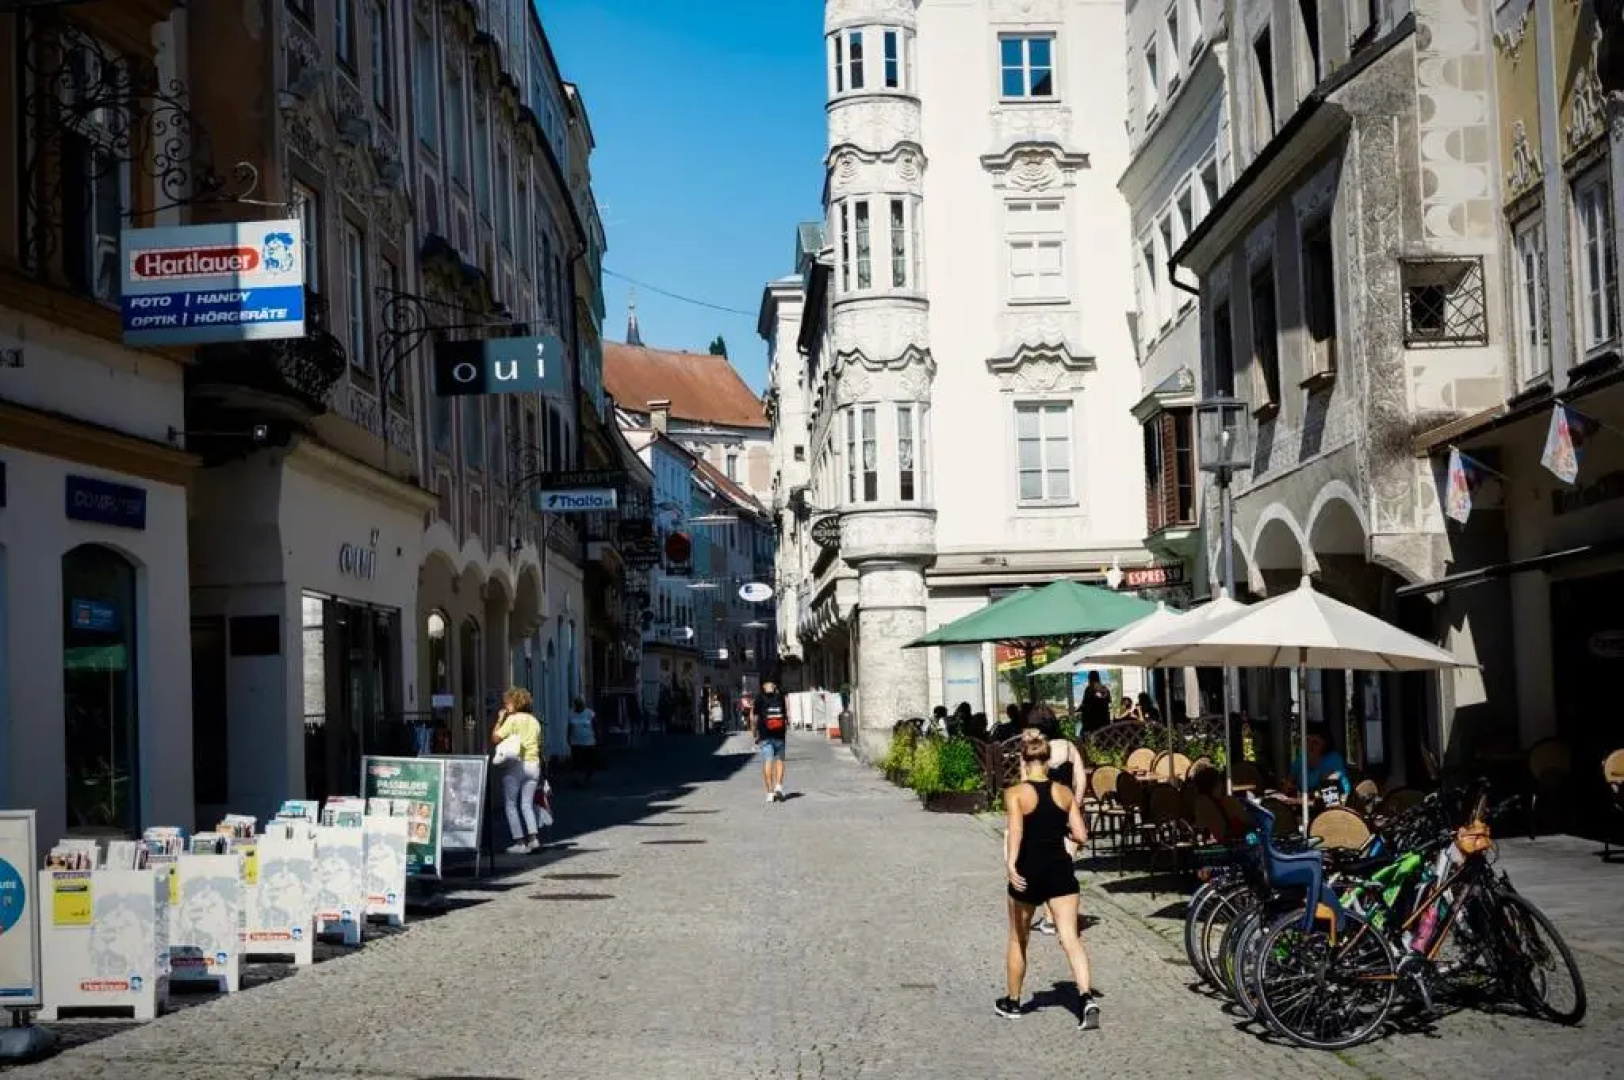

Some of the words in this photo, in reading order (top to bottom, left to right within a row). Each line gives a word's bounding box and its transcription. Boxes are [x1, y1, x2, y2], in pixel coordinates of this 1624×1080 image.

[143, 251, 251, 275] Hartlauer
[130, 295, 172, 309] FOTO
[196, 291, 252, 305] HANDY
[131, 313, 178, 327] OPTIK
[193, 307, 289, 325] HÖRGERÄTE
[452, 342, 546, 383] oui
[1127, 568, 1180, 586] ESPRESSO
